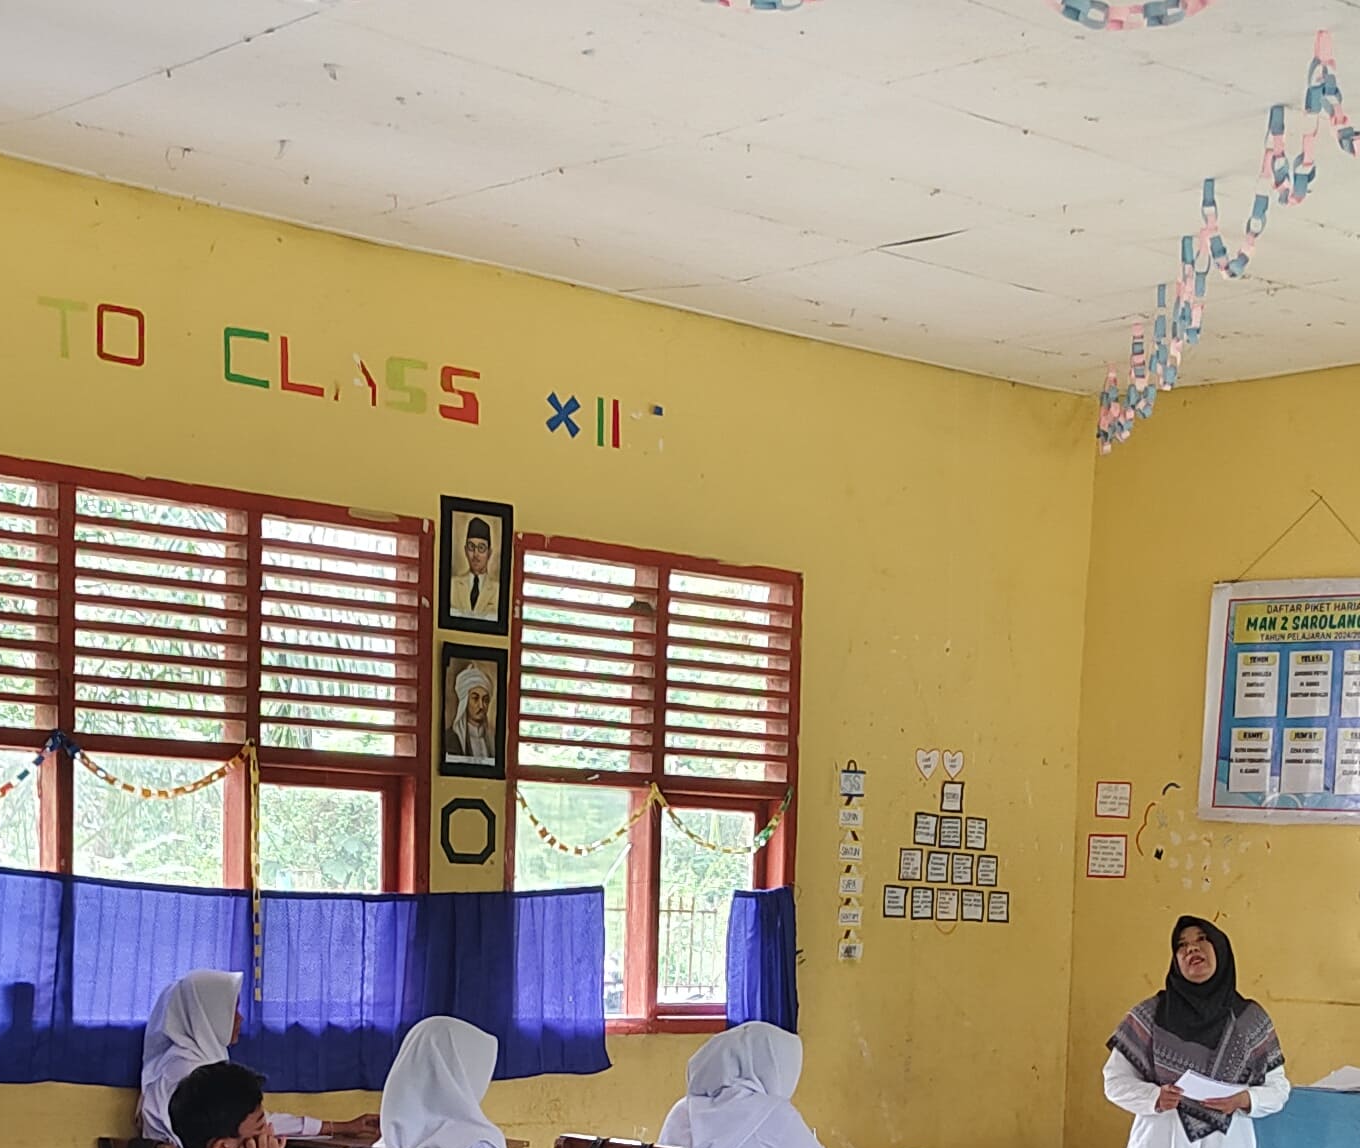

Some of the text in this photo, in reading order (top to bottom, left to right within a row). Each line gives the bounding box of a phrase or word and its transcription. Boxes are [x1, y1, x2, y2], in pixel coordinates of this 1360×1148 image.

[39, 296, 145, 368] TO
[1267, 603, 1303, 614] DAFTAR
[1304, 602, 1331, 613] PIKET
[1246, 617, 1278, 632] MAN
[1280, 616, 1289, 631] 2
[1260, 632, 1286, 641] TAHUN
[1287, 631, 1332, 641] PELAJARAN
